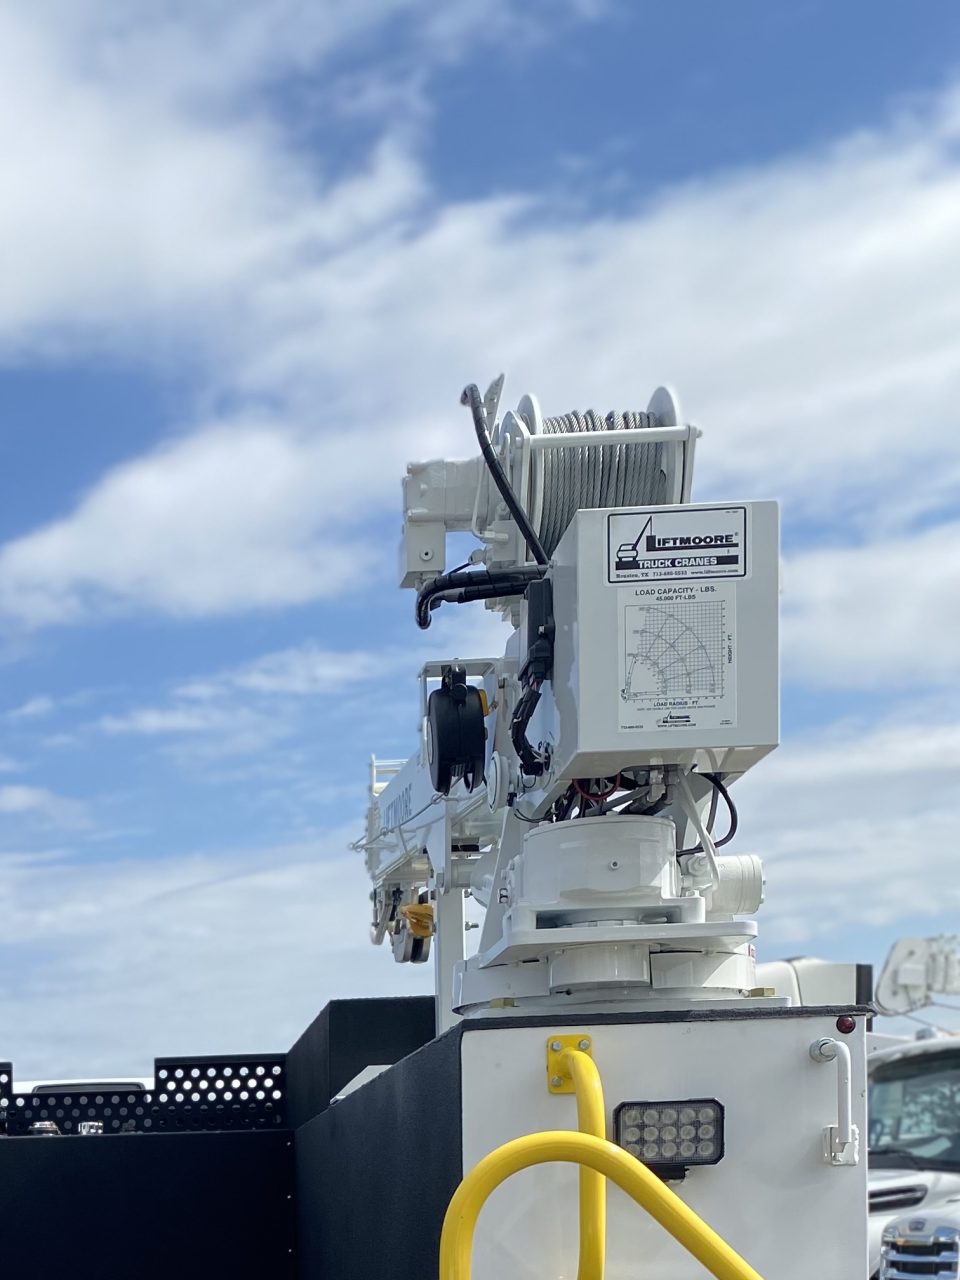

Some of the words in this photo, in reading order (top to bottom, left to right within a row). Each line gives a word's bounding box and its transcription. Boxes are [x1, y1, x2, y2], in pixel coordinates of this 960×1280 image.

[646, 534, 738, 552] LIFTMOORE
[638, 558, 672, 569] TRUCK
[675, 556, 718, 567] CRANES
[658, 586, 694, 595] CAPACITY
